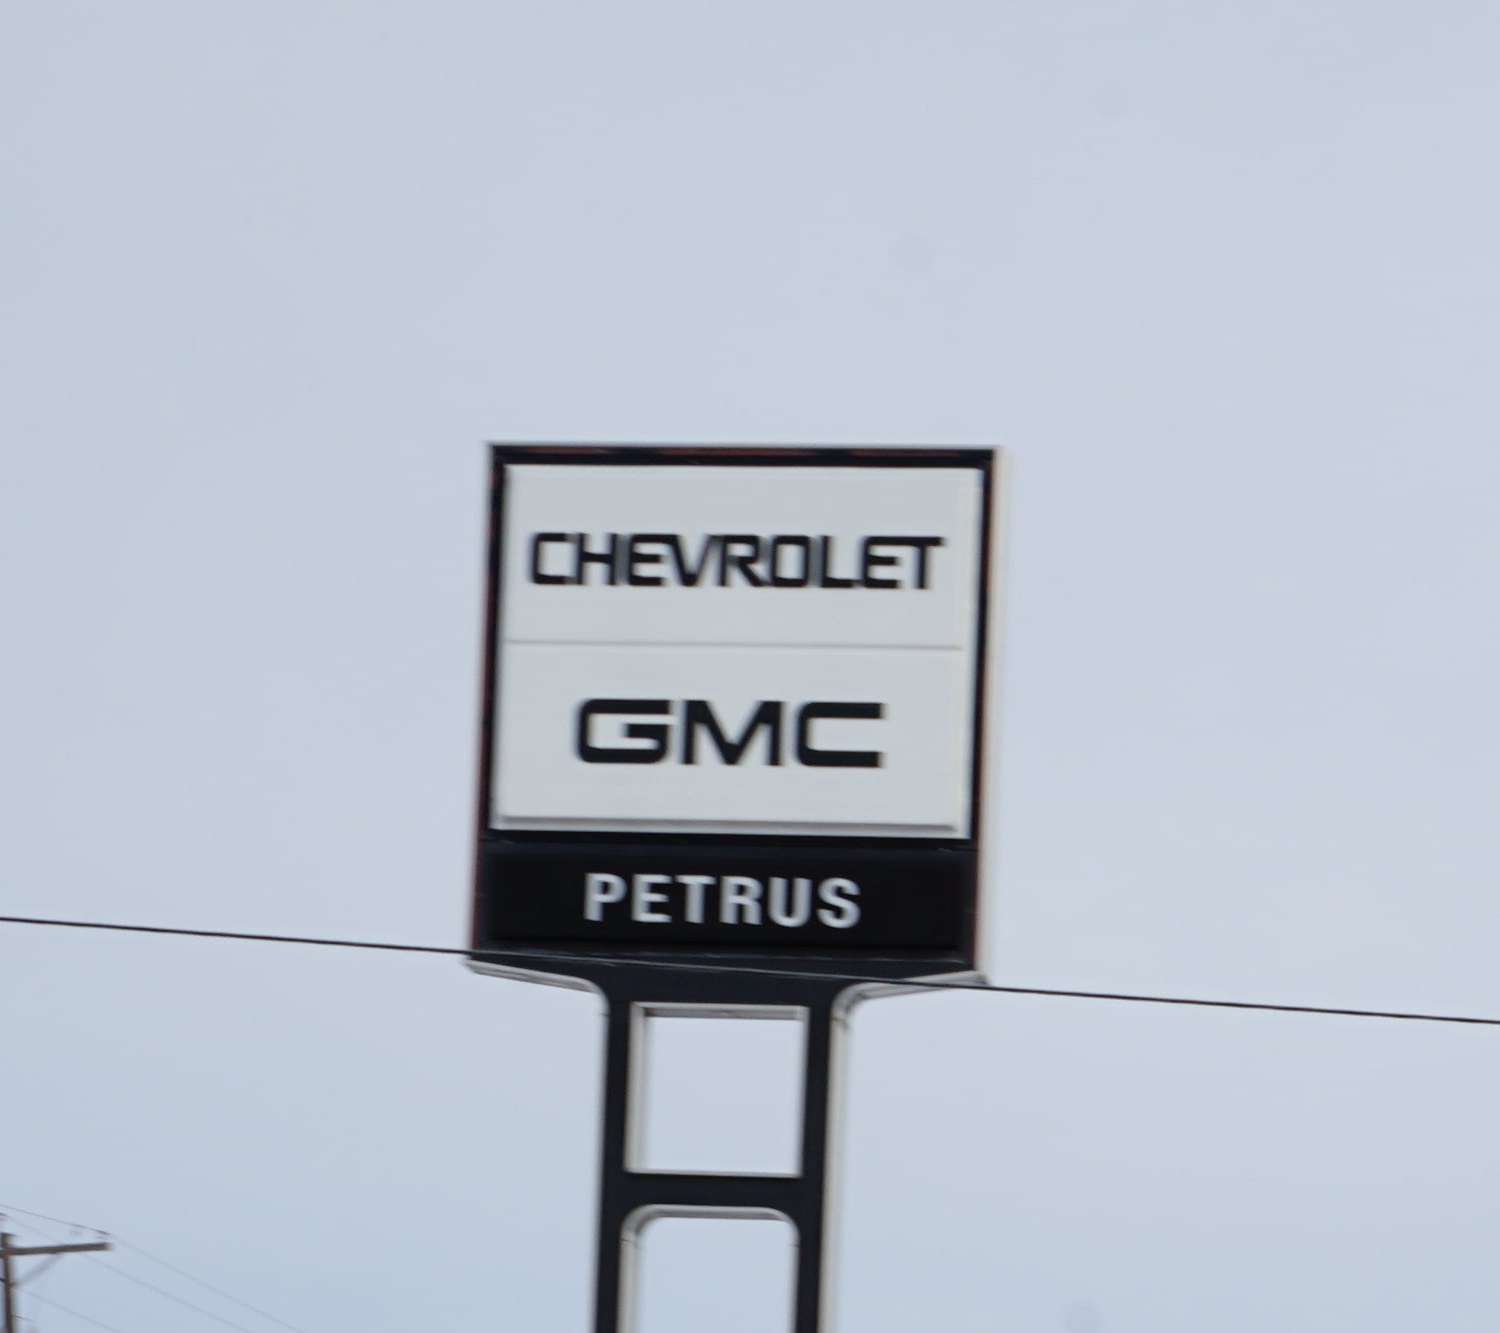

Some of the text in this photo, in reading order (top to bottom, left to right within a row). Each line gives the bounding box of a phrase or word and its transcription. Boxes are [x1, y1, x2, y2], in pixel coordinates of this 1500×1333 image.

[531, 530, 945, 590] CHEVROLET
[577, 697, 885, 768] GMC
[583, 872, 862, 928] PETRUS
